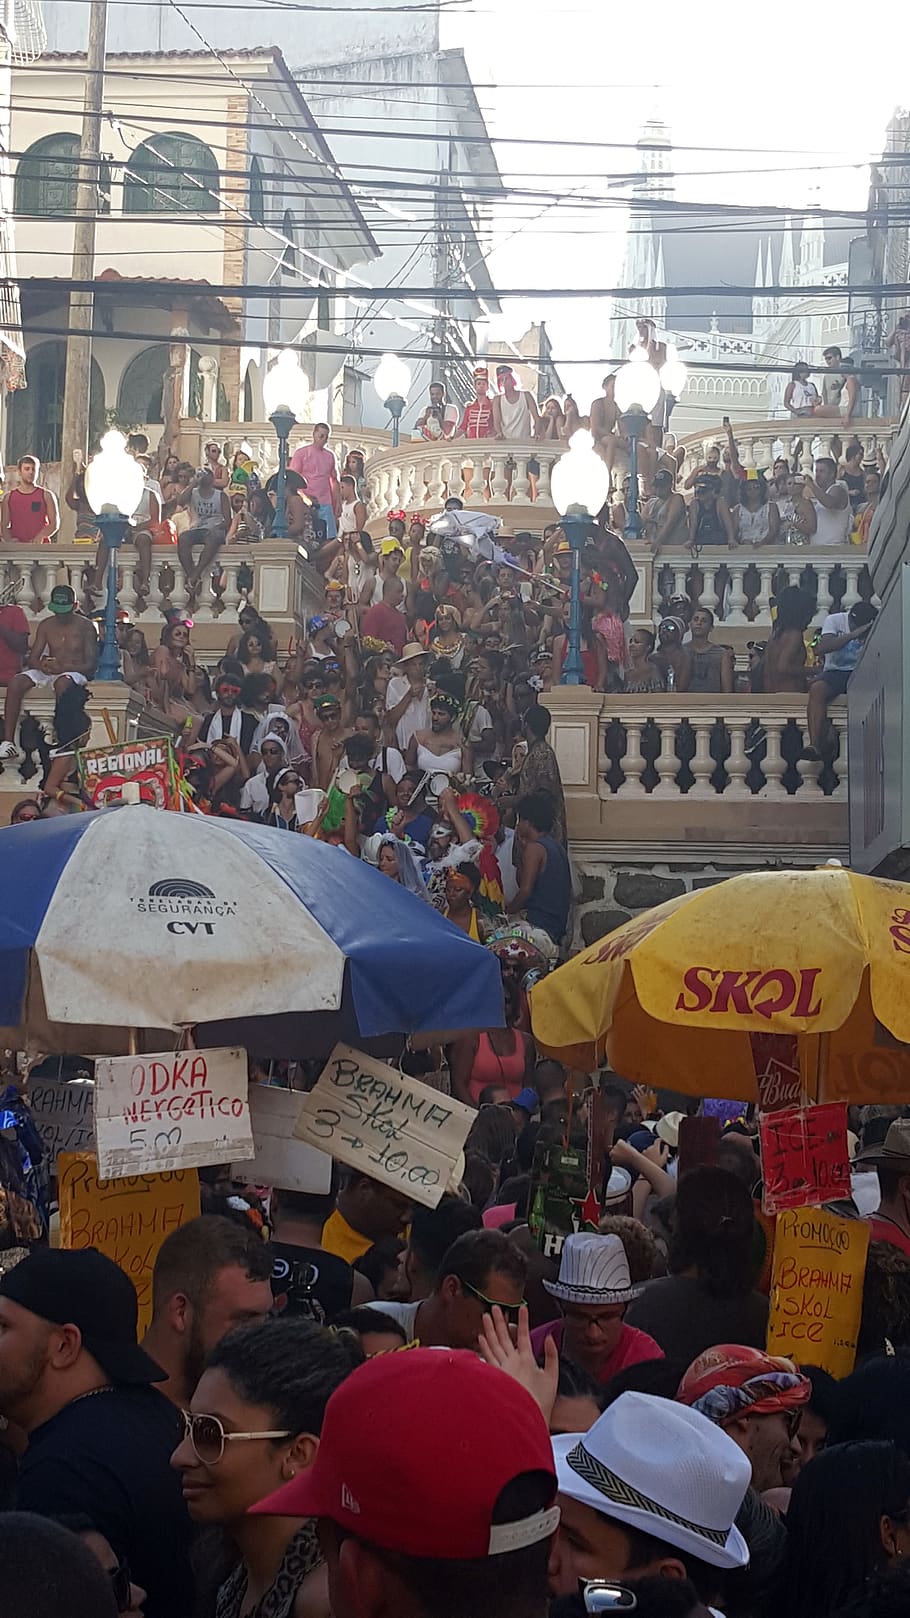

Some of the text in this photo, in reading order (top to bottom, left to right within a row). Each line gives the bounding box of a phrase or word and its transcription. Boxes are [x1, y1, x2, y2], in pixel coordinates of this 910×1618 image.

[87, 748, 165, 774] REGIONAL
[137, 903, 236, 917] SEGURANÇA
[167, 921, 216, 935] CVT
[675, 966, 822, 1019] SKOL
[330, 1059, 452, 1128] BRAHMA
[307, 1109, 341, 1138] 3
[70, 1203, 185, 1248] BRAHMA
[779, 1256, 851, 1295] BRAHMA
